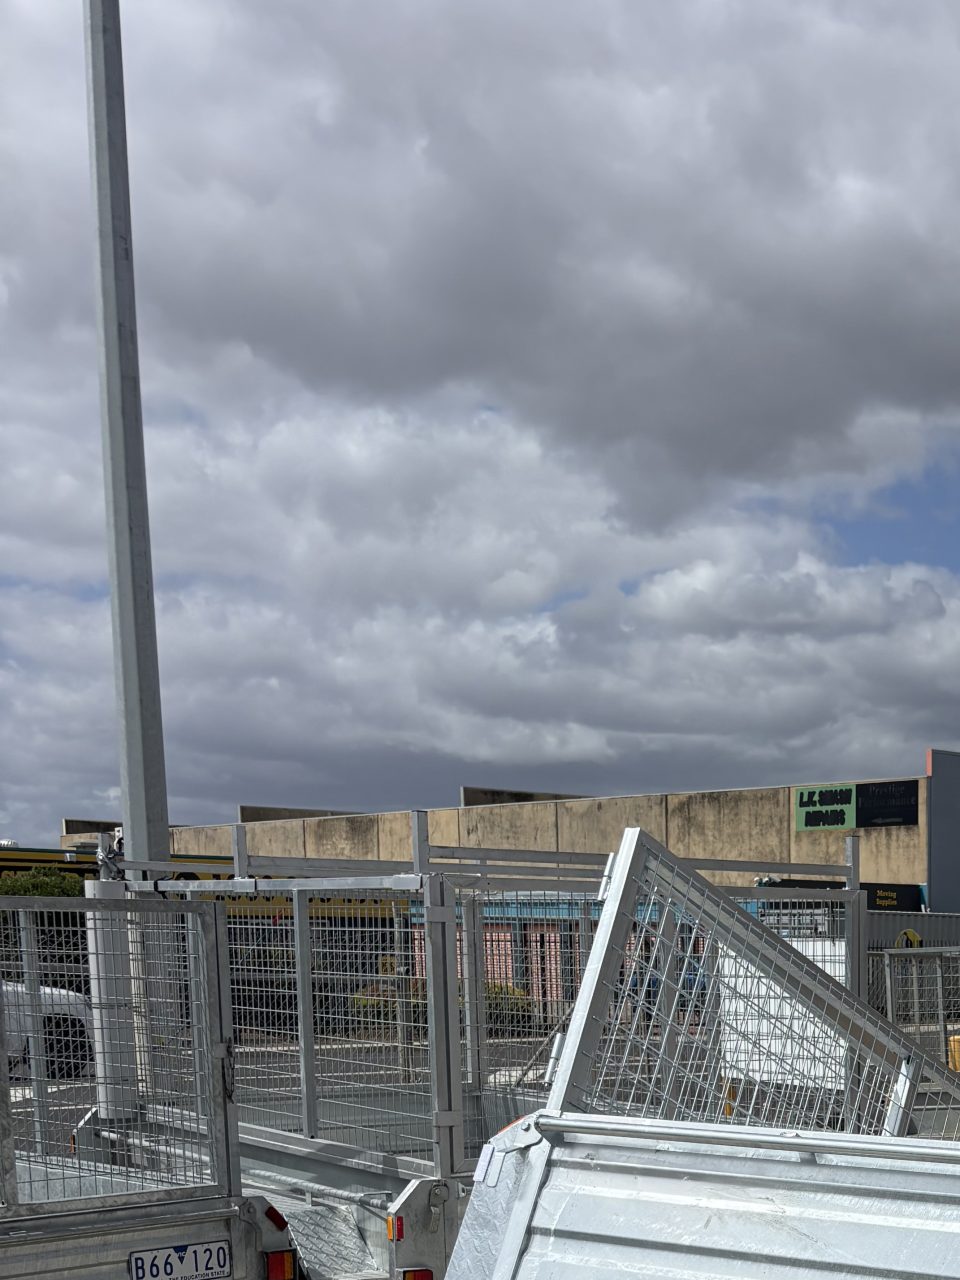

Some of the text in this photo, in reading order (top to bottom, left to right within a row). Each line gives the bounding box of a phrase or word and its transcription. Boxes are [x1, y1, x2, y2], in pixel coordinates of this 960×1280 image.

[134, 1246, 227, 1280] B66 120
[180, 1273, 210, 1280] EDUCATION
[210, 1270, 226, 1278] STATE
